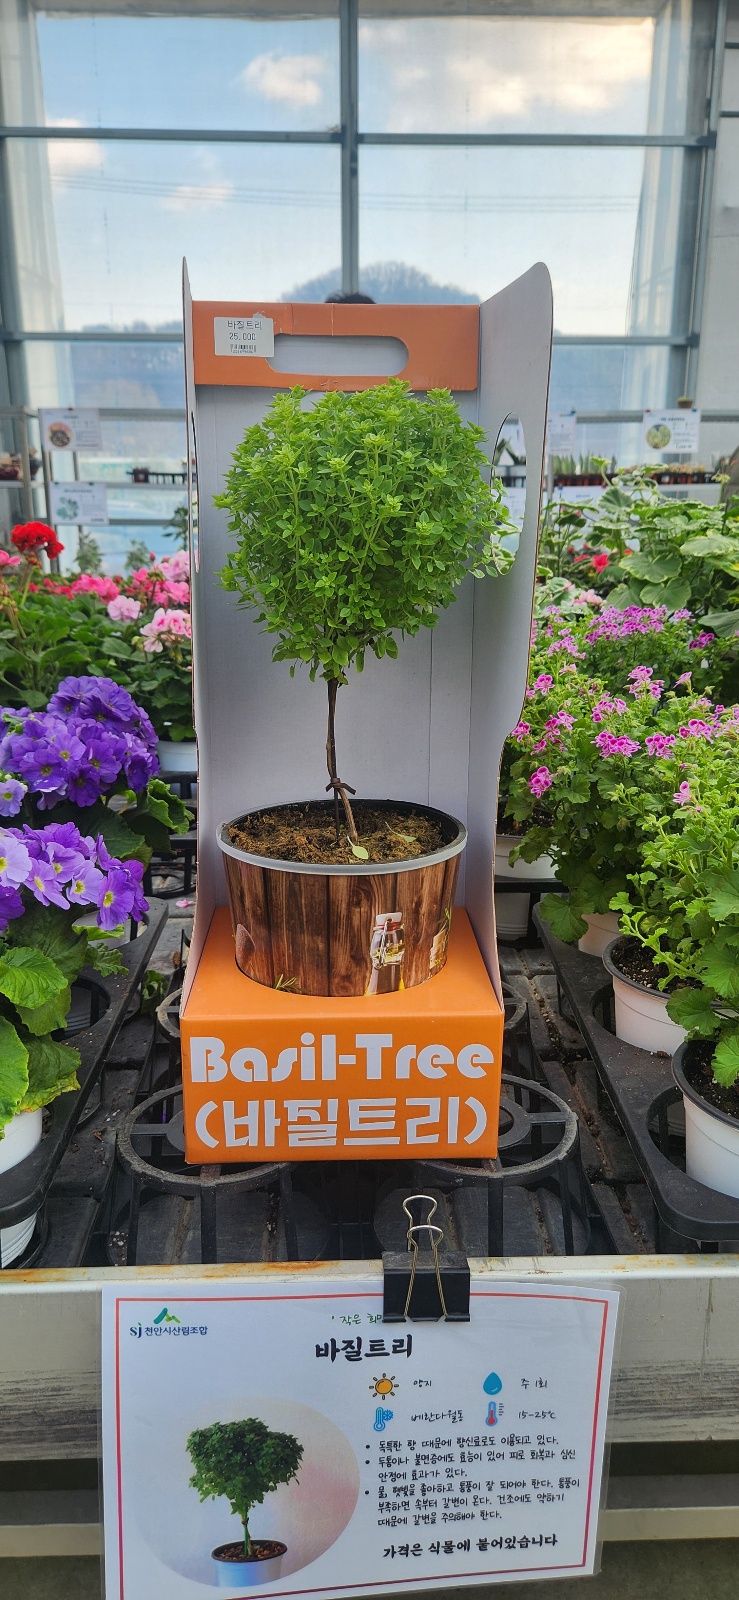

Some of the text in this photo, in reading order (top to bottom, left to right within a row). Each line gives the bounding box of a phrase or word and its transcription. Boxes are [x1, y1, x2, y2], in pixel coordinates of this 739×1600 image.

[228, 320, 262, 330] 바질트리
[189, 1032, 495, 1083] Basil-Tree
[195, 1096, 487, 1149] (바질트리)
[145, 1326, 208, 1336] 천안시산림조합
[315, 1334, 413, 1363] 바질트리
[413, 1379, 431, 1387] 양지
[521, 1379, 529, 1389] 주
[411, 1410, 463, 1423] 베란다월동
[379, 1433, 558, 1453] 독특한 향 때문에 향신료로도 이용되고 있다.
[379, 1449, 575, 1468] 두통이나 불면증에도 효능이 있어 피로 회복과 심신
[378, 1468, 467, 1482] 안정에 효과가 있다.
[393, 1484, 415, 1497] 햇빛을
[420, 1483, 454, 1496] 좋아하고
[459, 1481, 480, 1493] 통풍이
[486, 1480, 495, 1491] 잘
[500, 1480, 526, 1489] 되어야
[531, 1479, 553, 1489] 한다.
[558, 1477, 579, 1489] 통풍이
[378, 1501, 410, 1513] 부족하면
[415, 1499, 437, 1510] 속부터
[442, 1498, 467, 1508] 갈변이
[472, 1496, 492, 1506] 온다.
[497, 1495, 531, 1504] 건조에도
[378, 1510, 502, 1527] 때문에 갈변을 주의해야 한다.
[382, 1533, 558, 1559] 가격은 식물에 붙어있습니다
